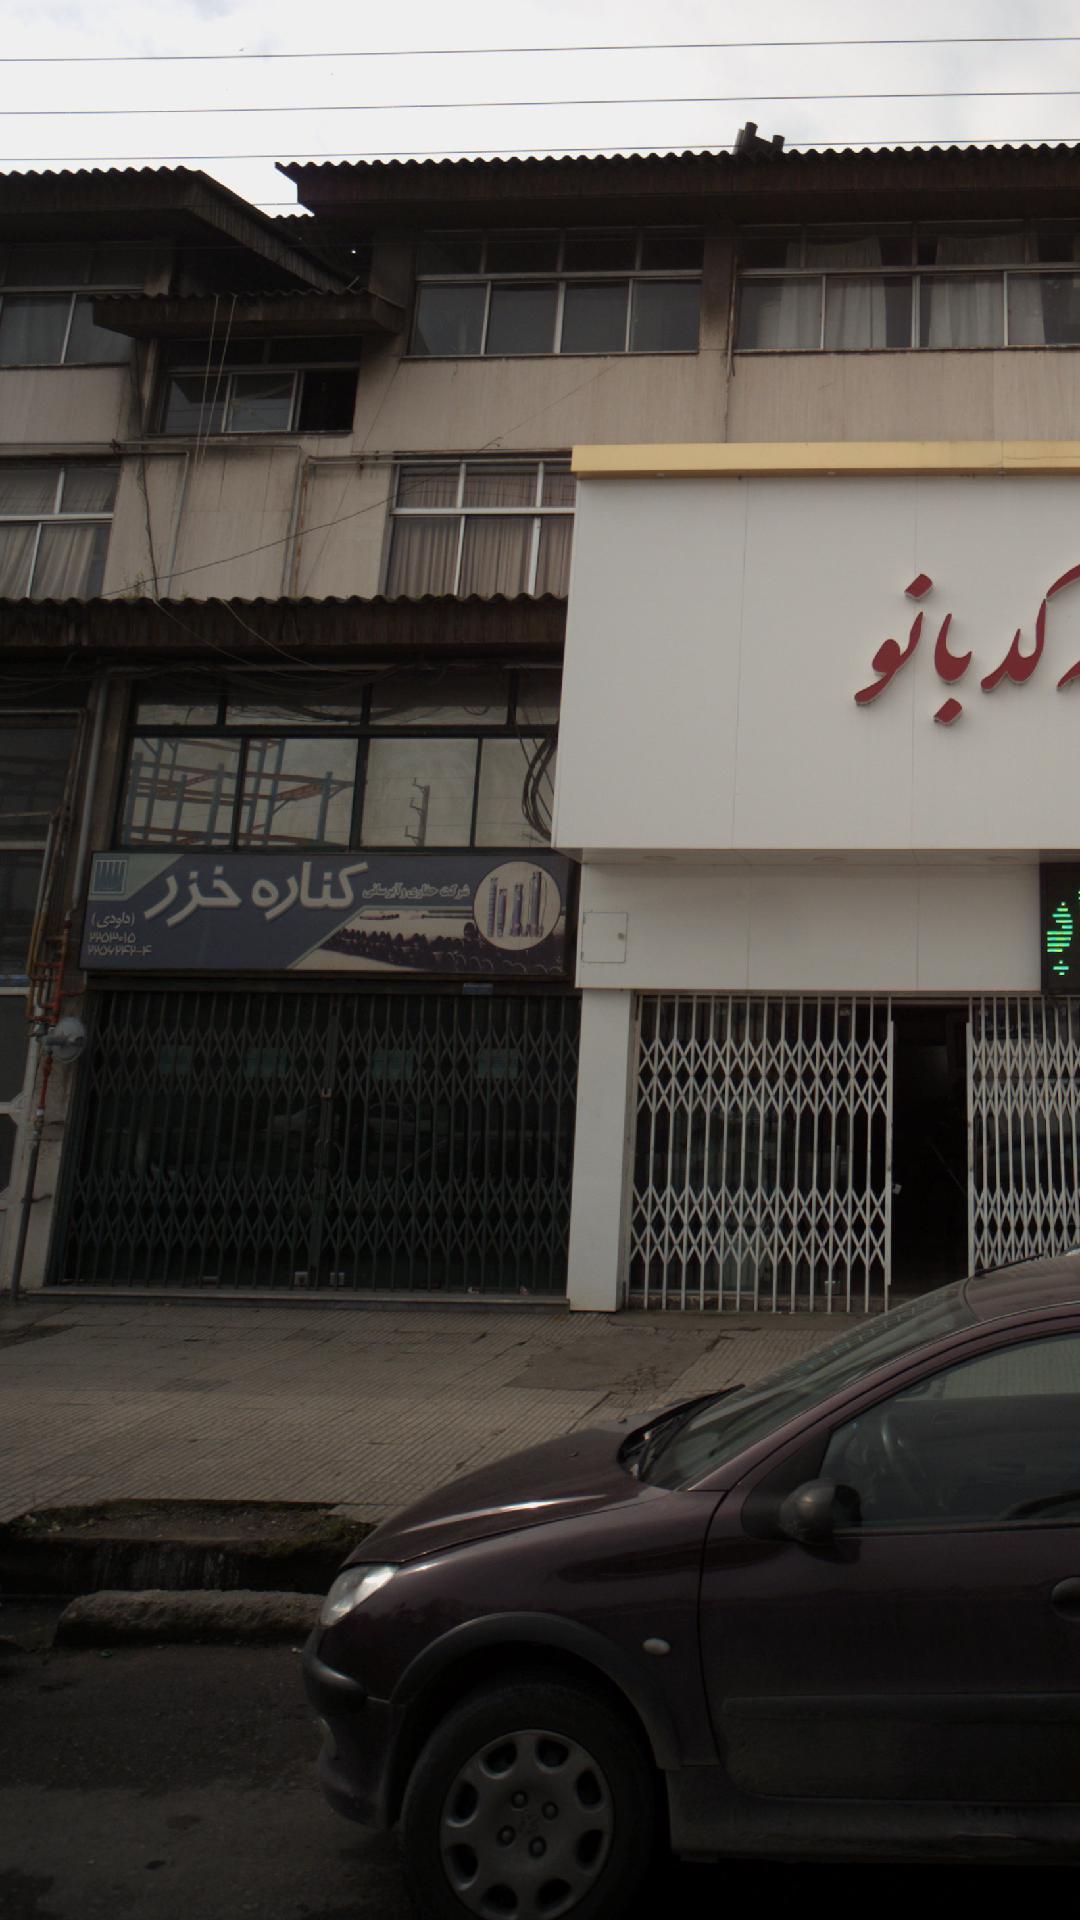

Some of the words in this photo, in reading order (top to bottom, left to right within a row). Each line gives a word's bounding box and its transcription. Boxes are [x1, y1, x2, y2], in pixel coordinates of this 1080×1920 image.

[144, 865, 241, 926] خزر
[251, 861, 368, 920] کناره
[408, 882, 439, 899] حفاری
[439, 883, 471, 900] شرکت
